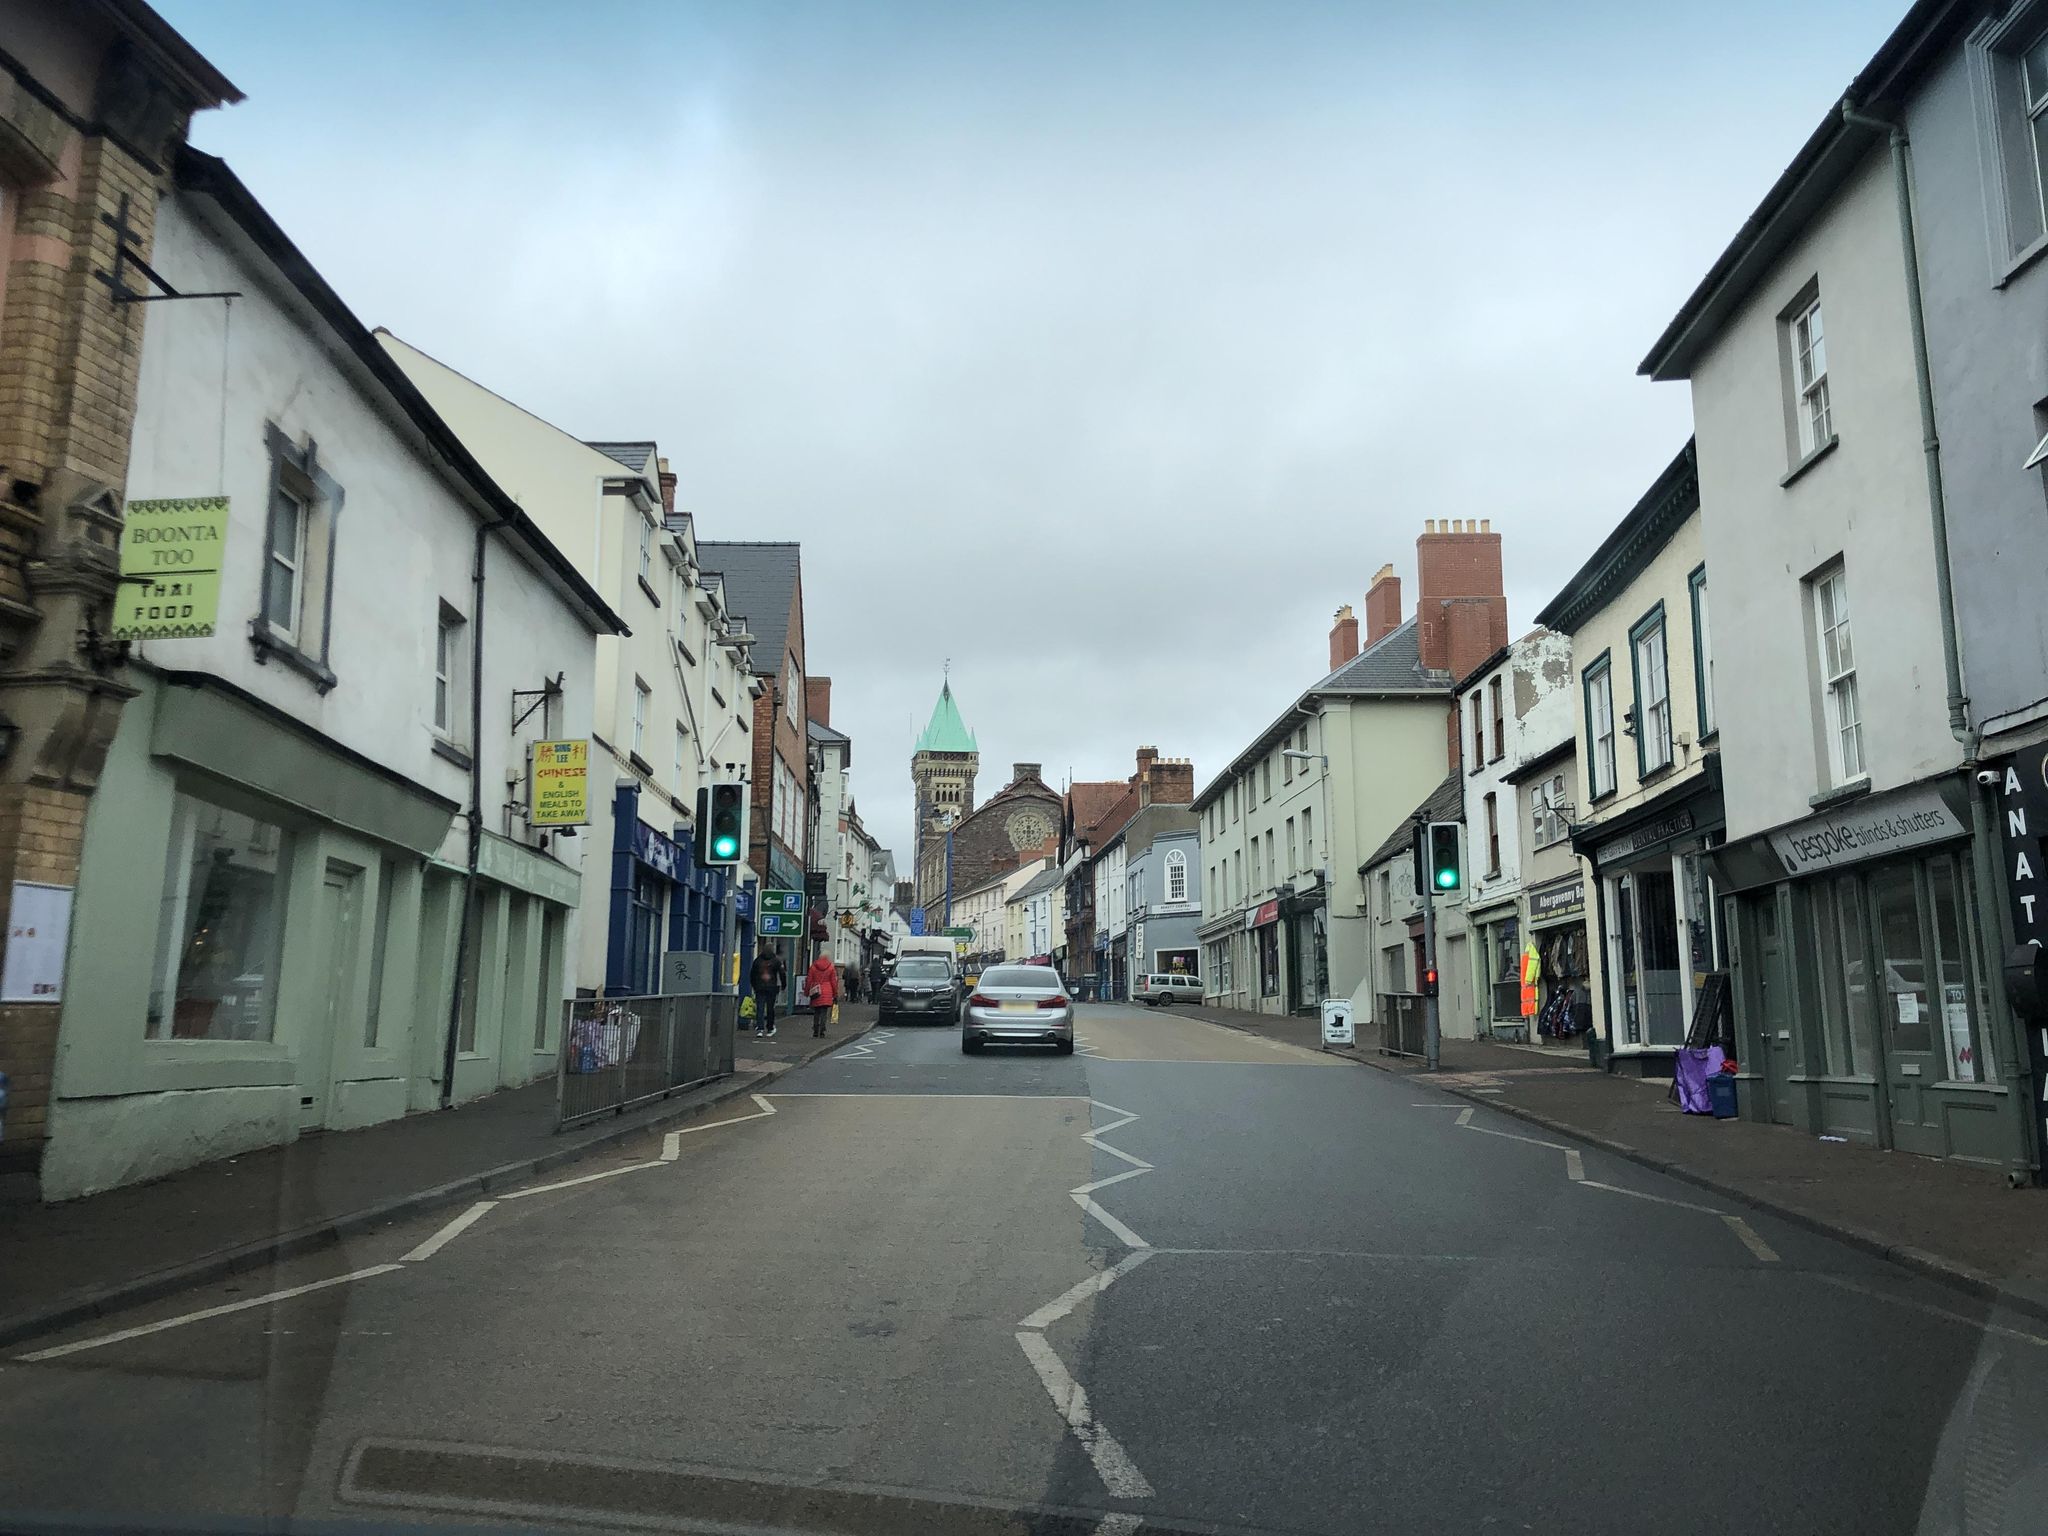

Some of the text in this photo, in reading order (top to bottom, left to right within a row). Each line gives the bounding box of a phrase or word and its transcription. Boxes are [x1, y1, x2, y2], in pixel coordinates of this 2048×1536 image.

[132, 525, 219, 544] BOONTA
[152, 549, 194, 566] TOO
[141, 583, 193, 598] THAI
[134, 604, 193, 620] FOOD
[556, 754, 568, 763] LEE
[537, 768, 587, 778] CHINESE
[543, 790, 579, 799] ENGLISH
[540, 800, 569, 809] MEALS
[536, 809, 585, 818] TAKE AWAY
[1632, 827, 1656, 848] DENTAL
[1657, 815, 1690, 838] PRACTICE
[1787, 820, 1858, 864] bespoke
[1896, 808, 1945, 834] shutters
[1540, 890, 1574, 908] Abergavenny
